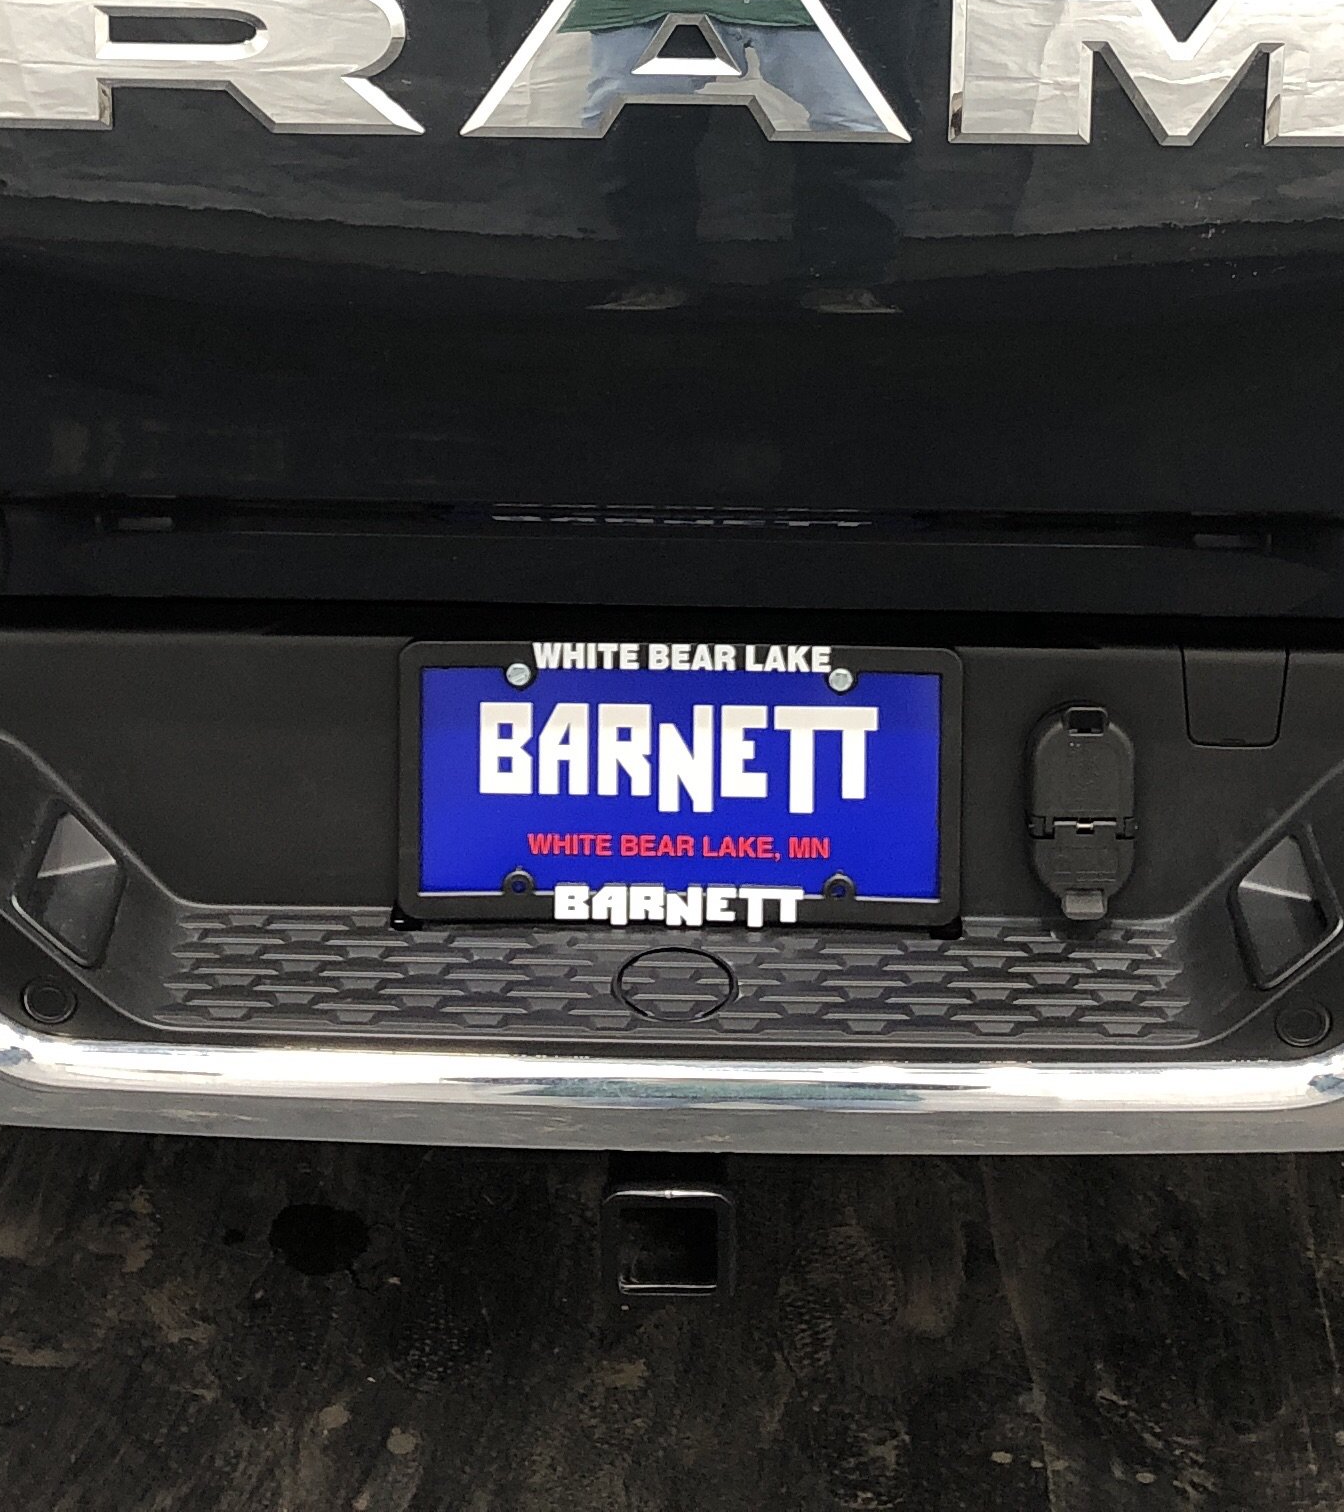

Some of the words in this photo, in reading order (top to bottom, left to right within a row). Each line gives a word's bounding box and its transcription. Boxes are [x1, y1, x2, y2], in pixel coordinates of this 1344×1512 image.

[533, 642, 639, 671] WHITE
[648, 644, 737, 671] BEAR
[746, 645, 832, 674] LAKE
[479, 701, 879, 814] BARNETT
[528, 833, 613, 857] WHITE
[620, 835, 695, 858] BEAR
[702, 836, 782, 862] LAKE,
[788, 837, 830, 860] MN
[554, 883, 805, 928] BARNETT
